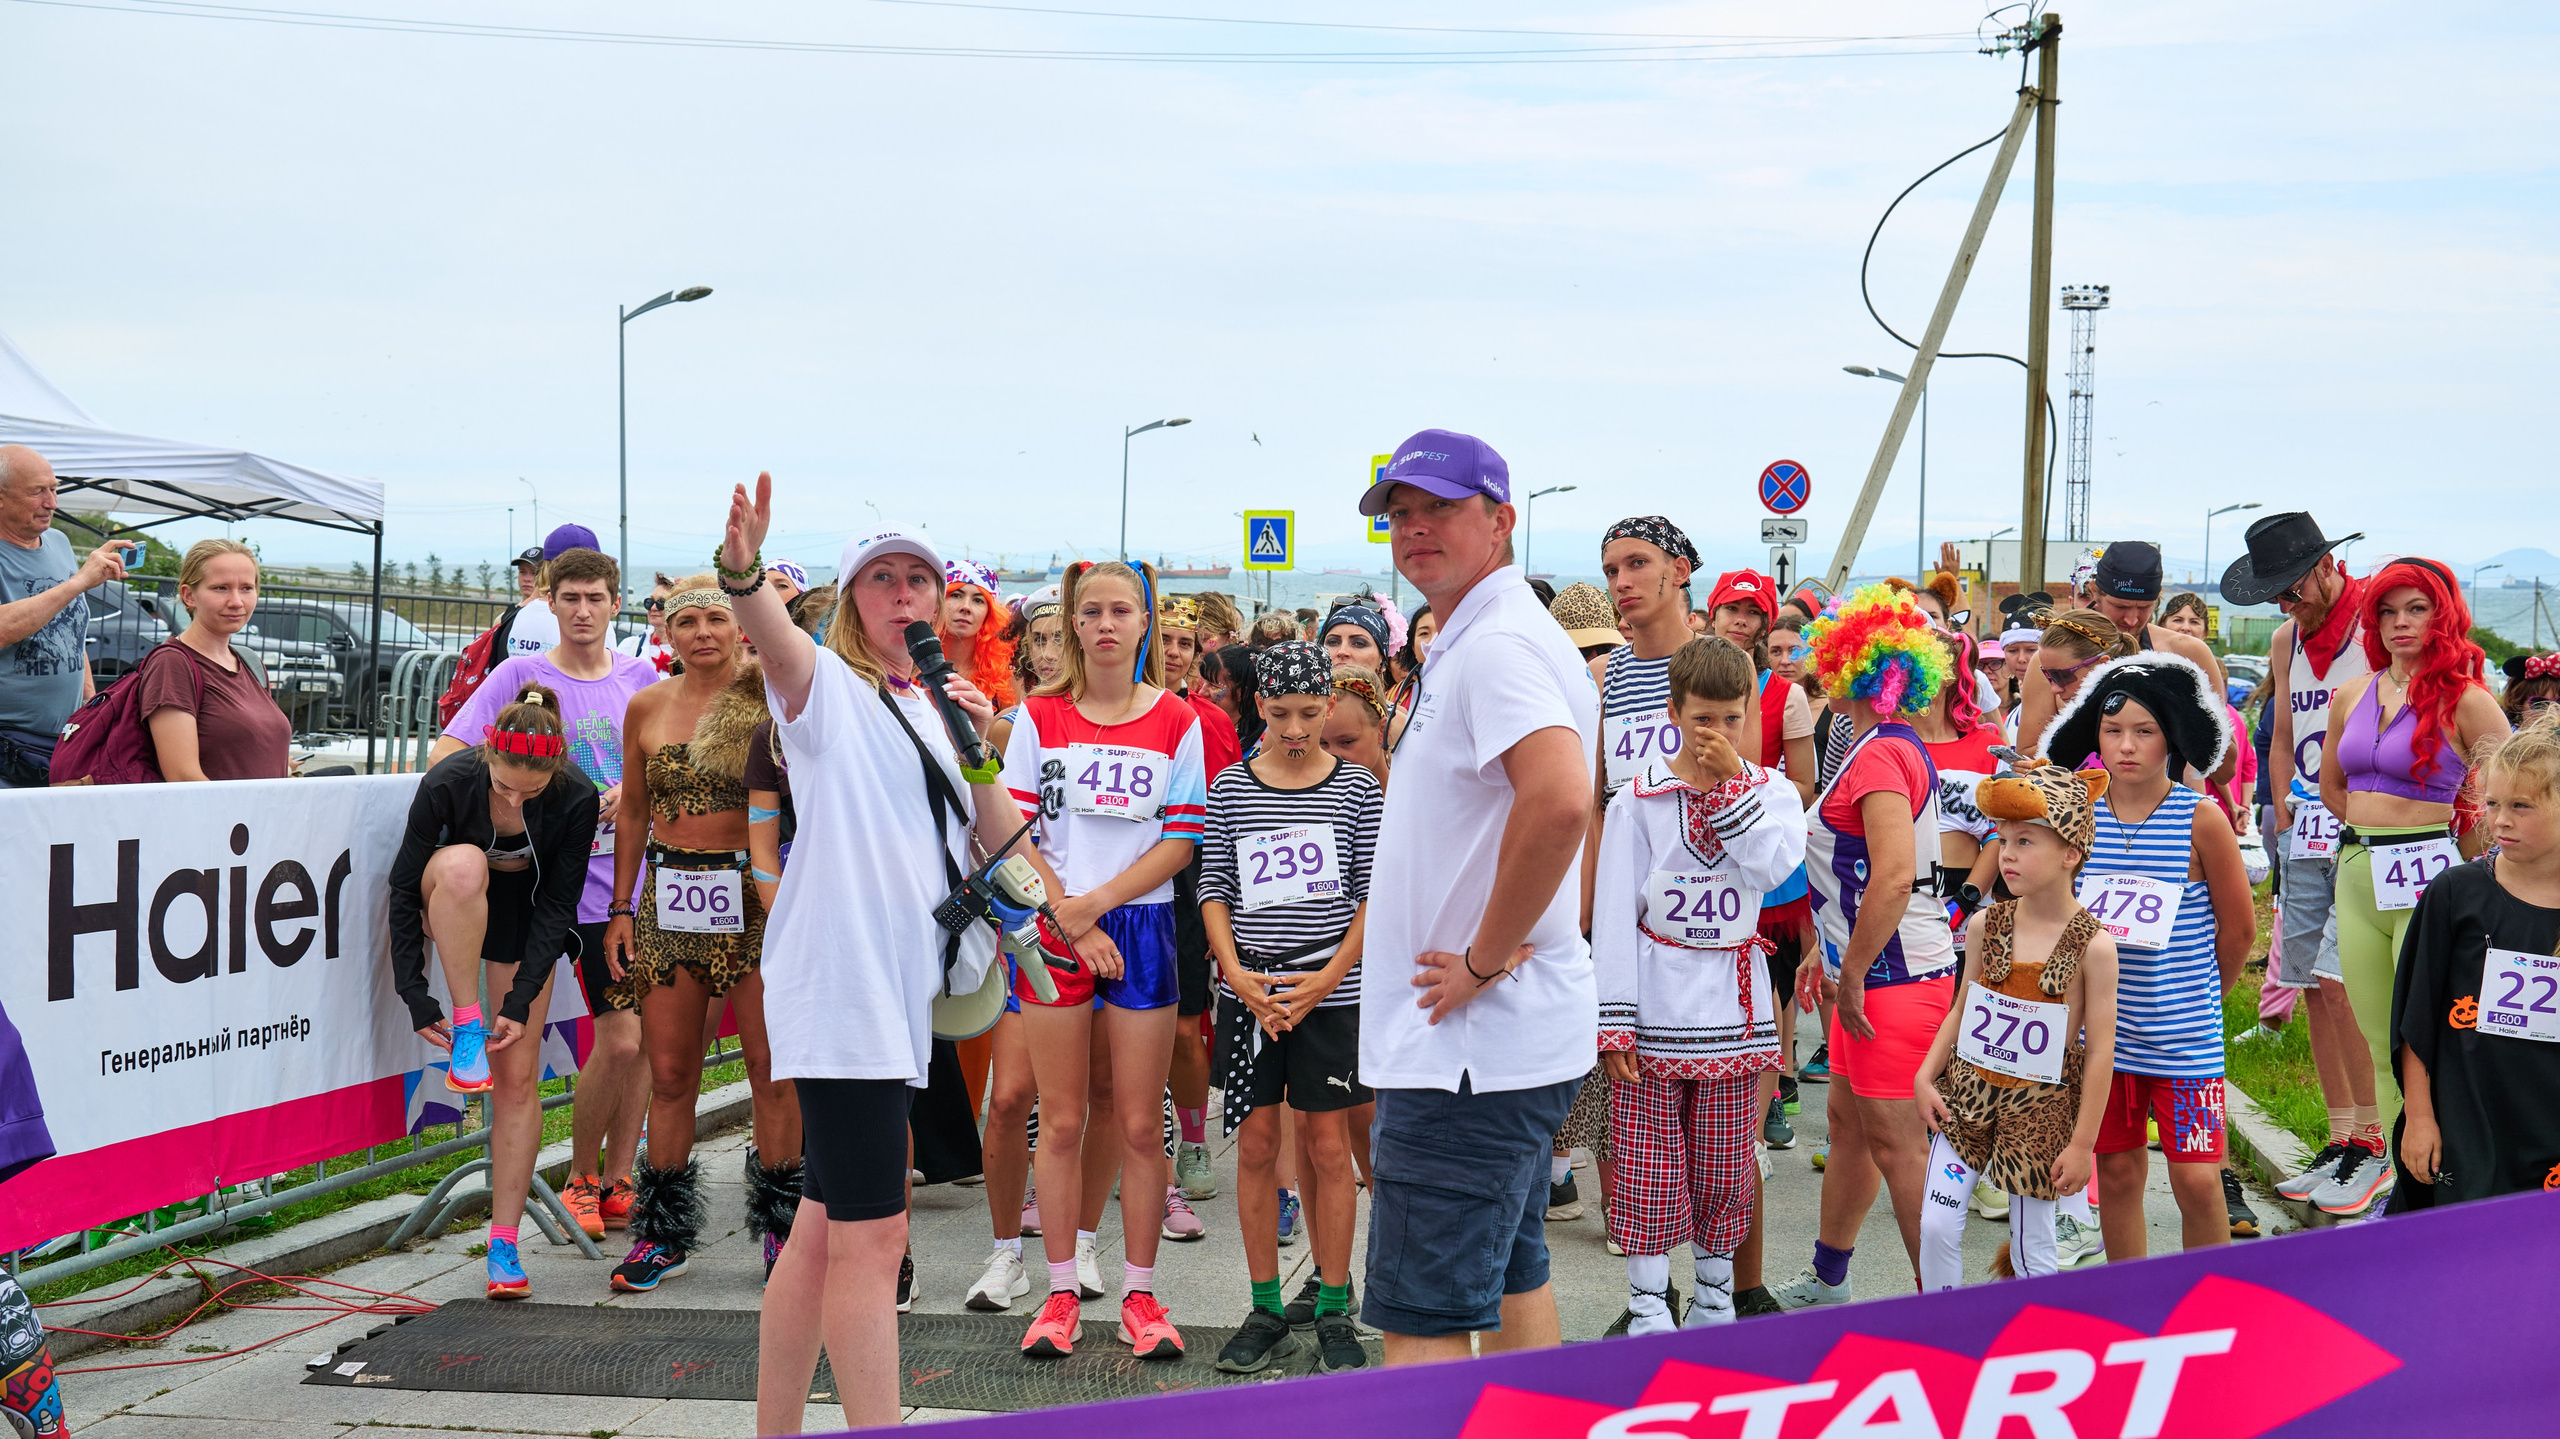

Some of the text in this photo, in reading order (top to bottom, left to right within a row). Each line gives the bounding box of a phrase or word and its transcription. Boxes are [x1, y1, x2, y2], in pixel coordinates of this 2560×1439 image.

[1400, 451, 1449, 464] SUPFEST
[1484, 475, 1504, 497] Haier
[26, 660, 60, 676] HEY
[576, 717, 611, 730] БЕЛЫЕ
[1635, 712, 1668, 722] SUPFEST
[577, 729, 611, 741] НОЧИ
[1615, 724, 1681, 760] 470
[1107, 749, 1146, 760] SUPFEST
[1077, 761, 1153, 798] 418
[1101, 796, 1124, 806] 3100
[2297, 815, 2342, 840] 413
[1271, 830, 1308, 842] SUPFEST
[2310, 842, 2325, 850] 3100
[2405, 843, 2439, 854] SUPFEST
[1249, 842, 1324, 885] 239
[1690, 873, 1728, 884] SUPFEST
[2117, 878, 2156, 889] SUPFEST
[1312, 881, 1335, 892] 1600
[666, 884, 730, 913] 206
[1664, 887, 1741, 922] 240
[48, 823, 352, 1002] Haier
[2087, 890, 2163, 924] 478
[714, 917, 735, 925] 1600
[1690, 929, 1715, 938] 1600
[2497, 971, 2558, 1014] 22
[1997, 998, 2040, 1014] SUPFEST
[2493, 1013, 2522, 1025] 1600
[1971, 1005, 2050, 1055] 270
[2498, 1027, 2518, 1035] Haier
[101, 1014, 311, 1076] Генеральный партнёр
[1988, 1046, 2013, 1061] 1600
[1930, 1189, 1961, 1209] Haier
